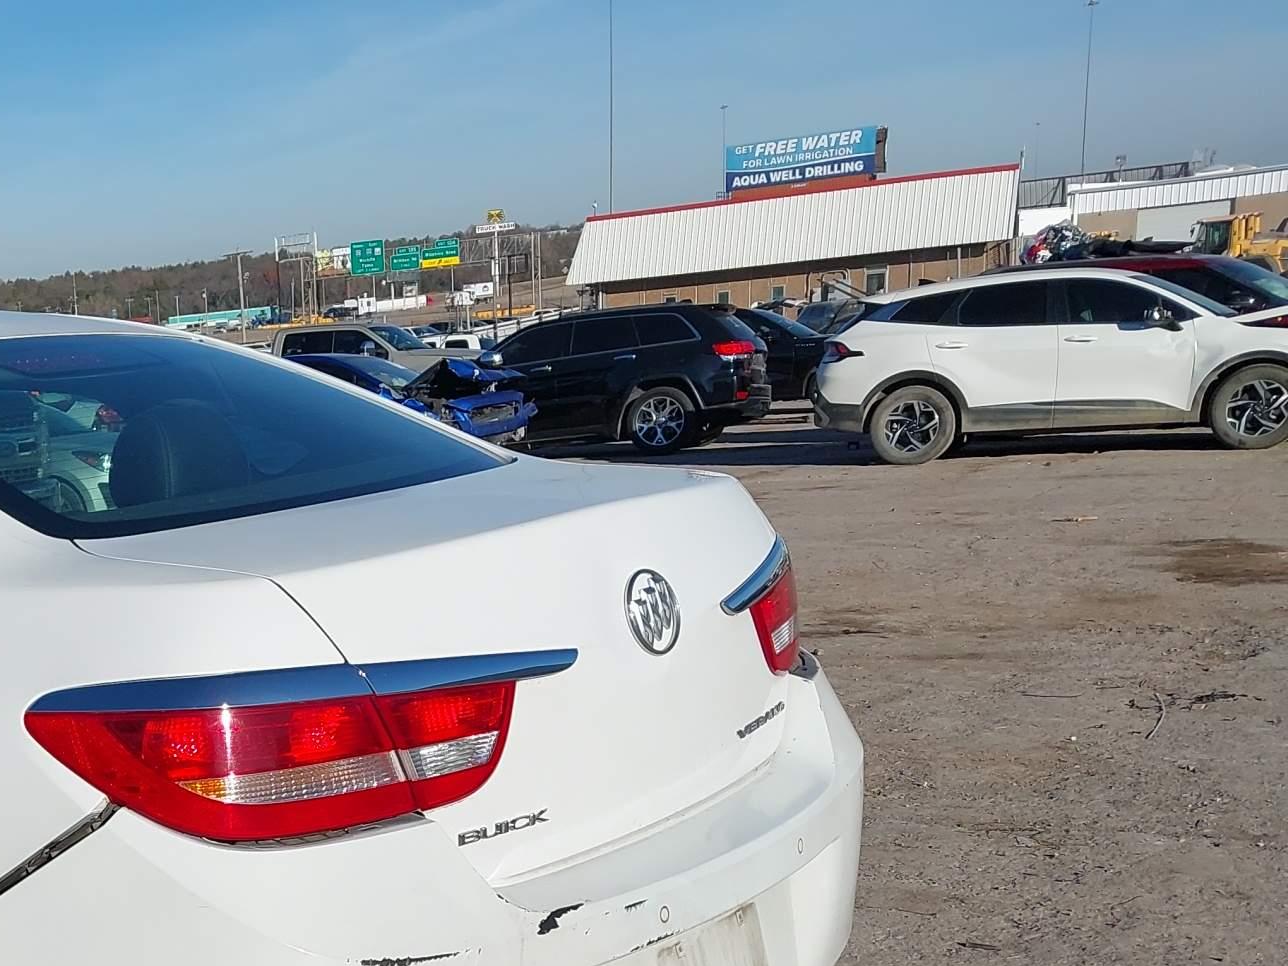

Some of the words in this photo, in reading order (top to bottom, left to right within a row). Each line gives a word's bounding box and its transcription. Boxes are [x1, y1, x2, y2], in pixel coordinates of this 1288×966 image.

[735, 144, 754, 156] GET
[755, 138, 798, 157] FREE
[801, 129, 863, 150] WATER
[743, 158, 763, 169] FOR
[765, 154, 793, 167] LAWN
[795, 146, 853, 162] IRRIGATION
[731, 170, 768, 188] AQUA
[770, 166, 803, 183] WELL
[805, 160, 864, 178] DRILLING
[458, 808, 550, 847] BUICK
